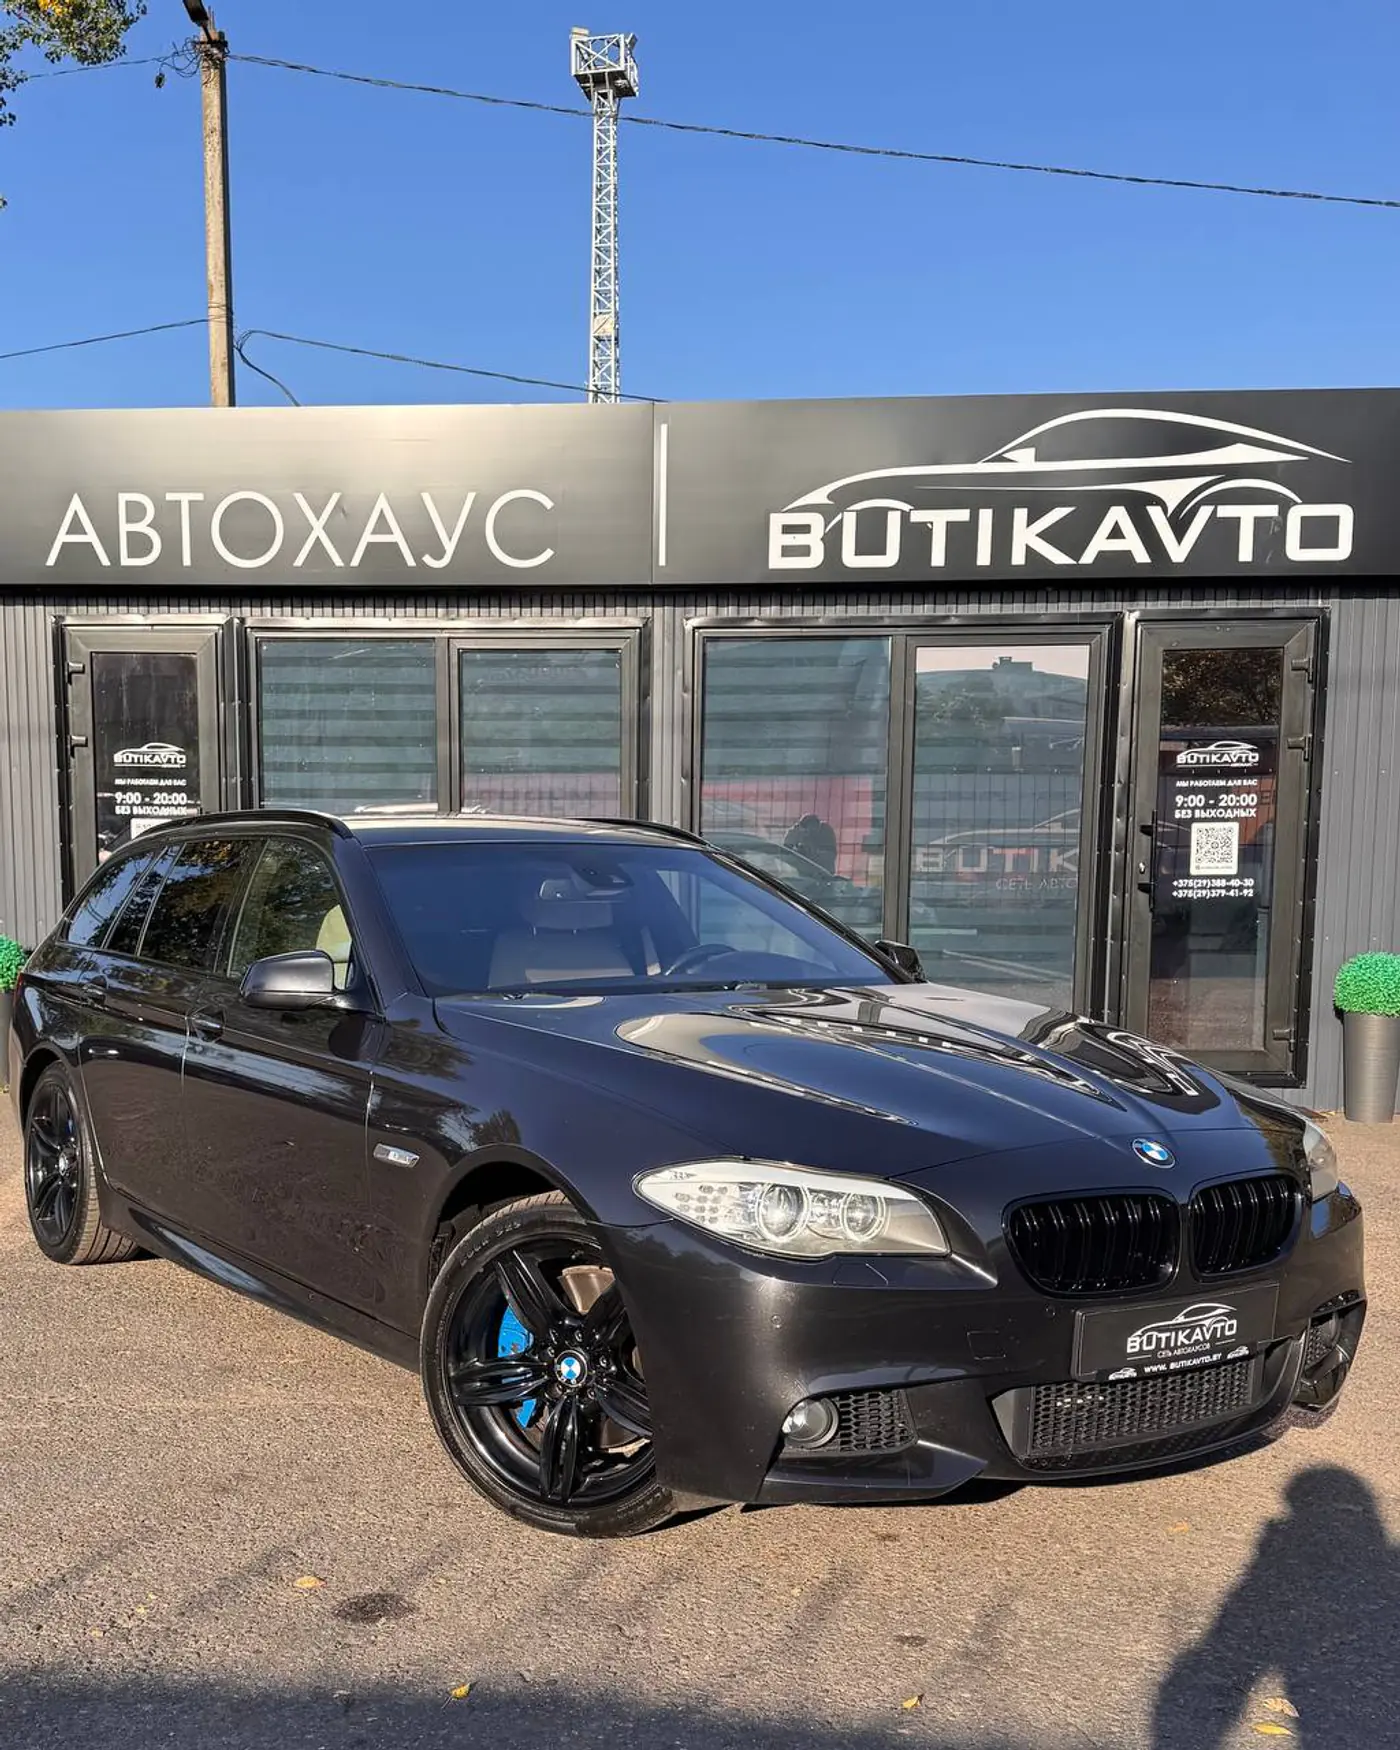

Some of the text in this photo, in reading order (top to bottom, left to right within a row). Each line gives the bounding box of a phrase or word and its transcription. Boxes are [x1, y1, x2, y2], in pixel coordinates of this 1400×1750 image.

[46, 489, 556, 569] АВТОХАУС
[768, 503, 1355, 570] BUTIKAVTO
[114, 754, 186, 763] BUTIKAVTO
[1176, 753, 1259, 764] BUTIKAVTO
[115, 792, 142, 804] 9:00
[153, 792, 187, 805] 20:00
[1175, 795, 1205, 807] 9:00
[1218, 794, 1258, 807] 20:00
[114, 805, 187, 816] БЕЗ ВЫХОДНЫХ
[1174, 808, 1257, 819] БЕЗ ВЫХОДНЫХ
[1126, 1319, 1238, 1354] BUTIKAVTO
